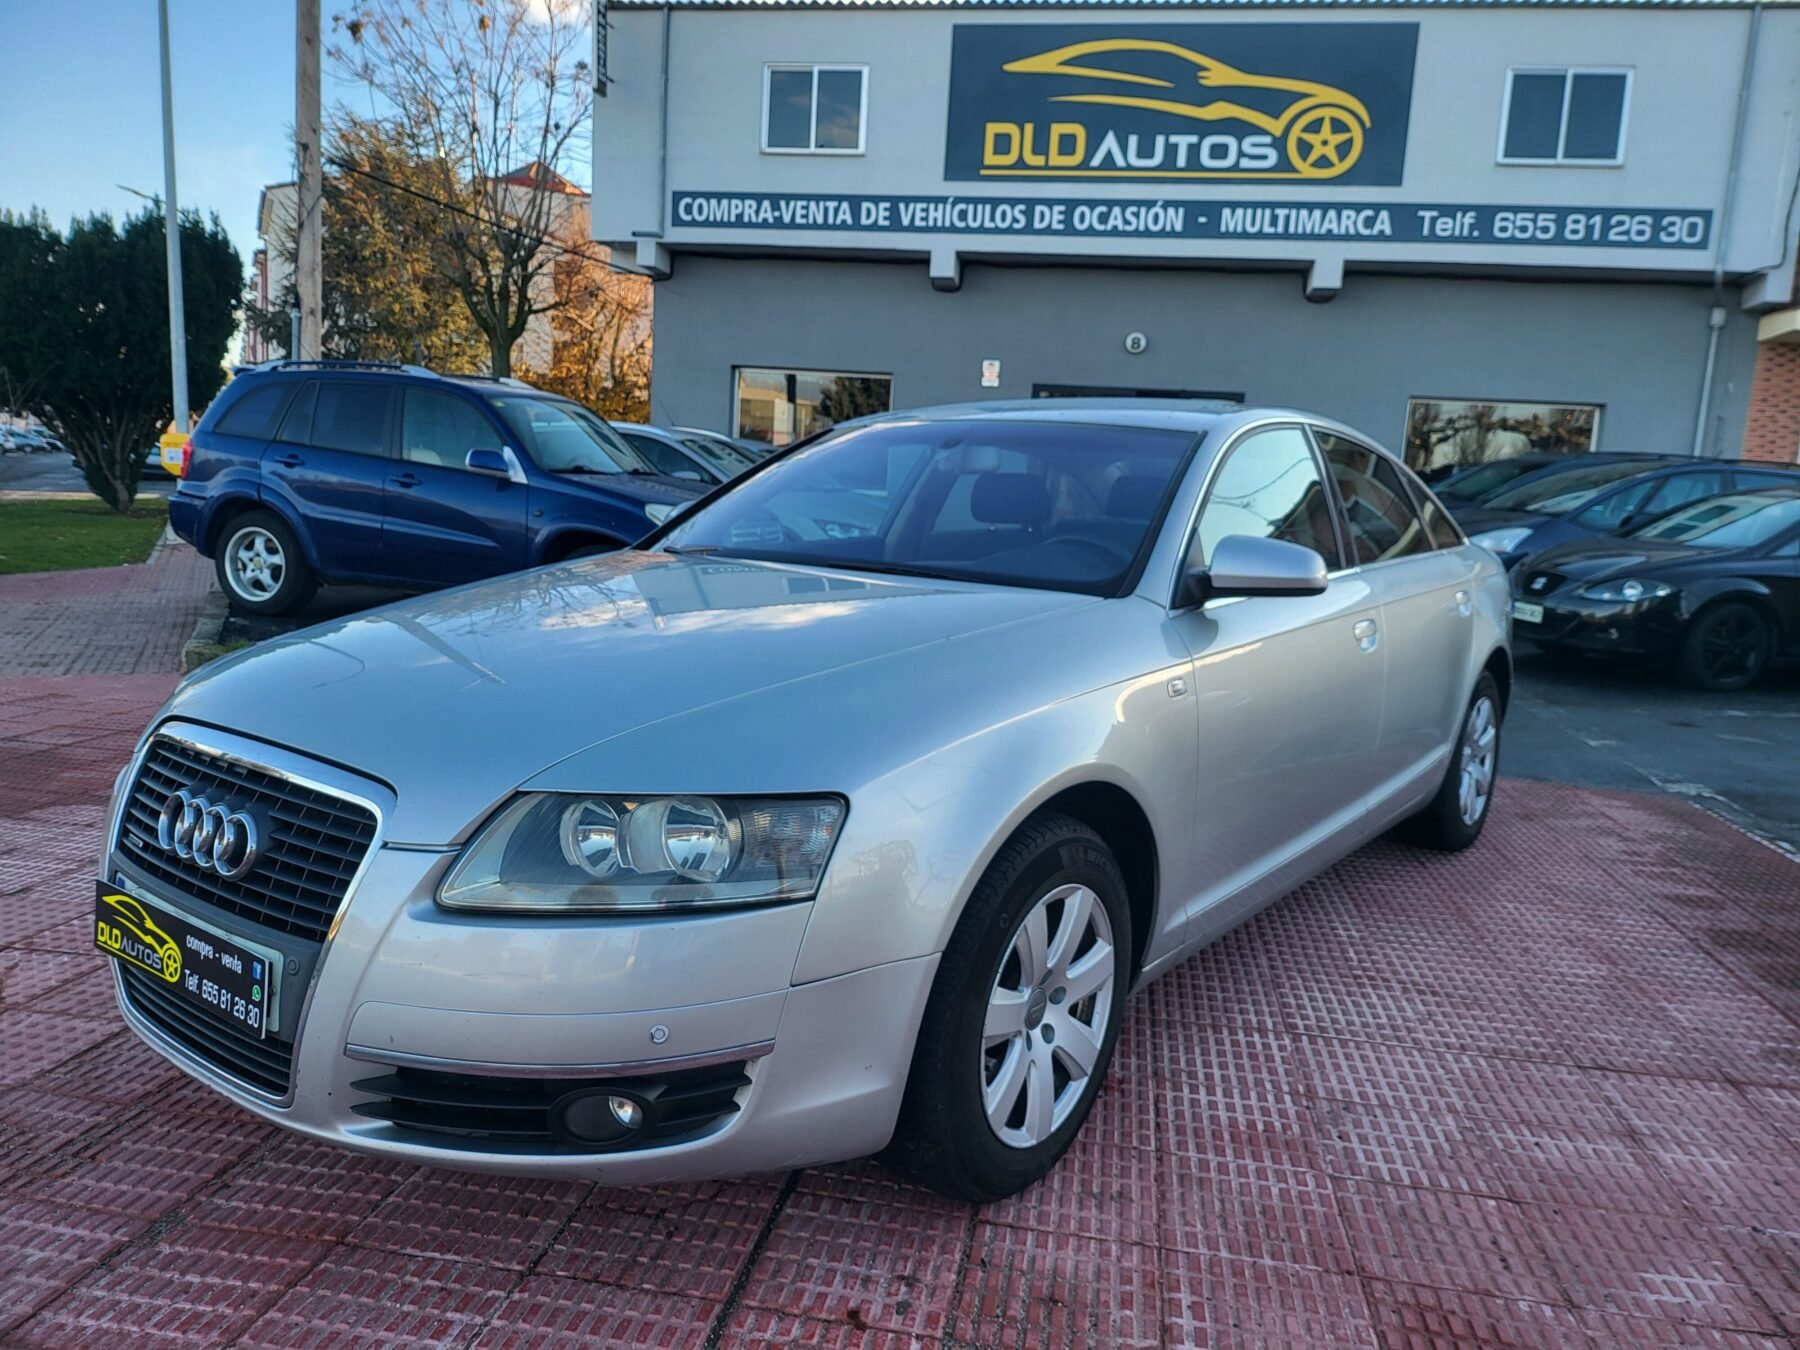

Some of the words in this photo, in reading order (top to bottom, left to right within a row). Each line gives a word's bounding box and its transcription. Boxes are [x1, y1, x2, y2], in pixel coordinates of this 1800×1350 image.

[983, 122, 1087, 167] DLD
[1089, 129, 1280, 169] AUTOS
[678, 197, 853, 225] COMPRA-VENTA
[860, 201, 891, 226] DE
[898, 197, 1027, 230] VEHÍCULOS
[1033, 205, 1066, 230] DE
[1073, 200, 1185, 232] OCASIÓN
[1219, 207, 1392, 236] MULTIMARCA
[1417, 210, 1480, 237] Telf.
[1492, 211, 1557, 240] 655
[1563, 213, 1602, 241] 81
[1608, 214, 1653, 243] 26
[1659, 216, 1704, 244] 30
[1131, 336, 1141, 350] 8
[97, 921, 122, 950] DLD
[121, 936, 162, 969] AUTOS
[186, 935, 214, 960] compra
[221, 952, 243, 975] venta
[184, 969, 200, 994] Telf.
[202, 979, 218, 1006] 655
[220, 989, 231, 1012] 81
[233, 997, 246, 1020] 26
[247, 1004, 260, 1028] 30
